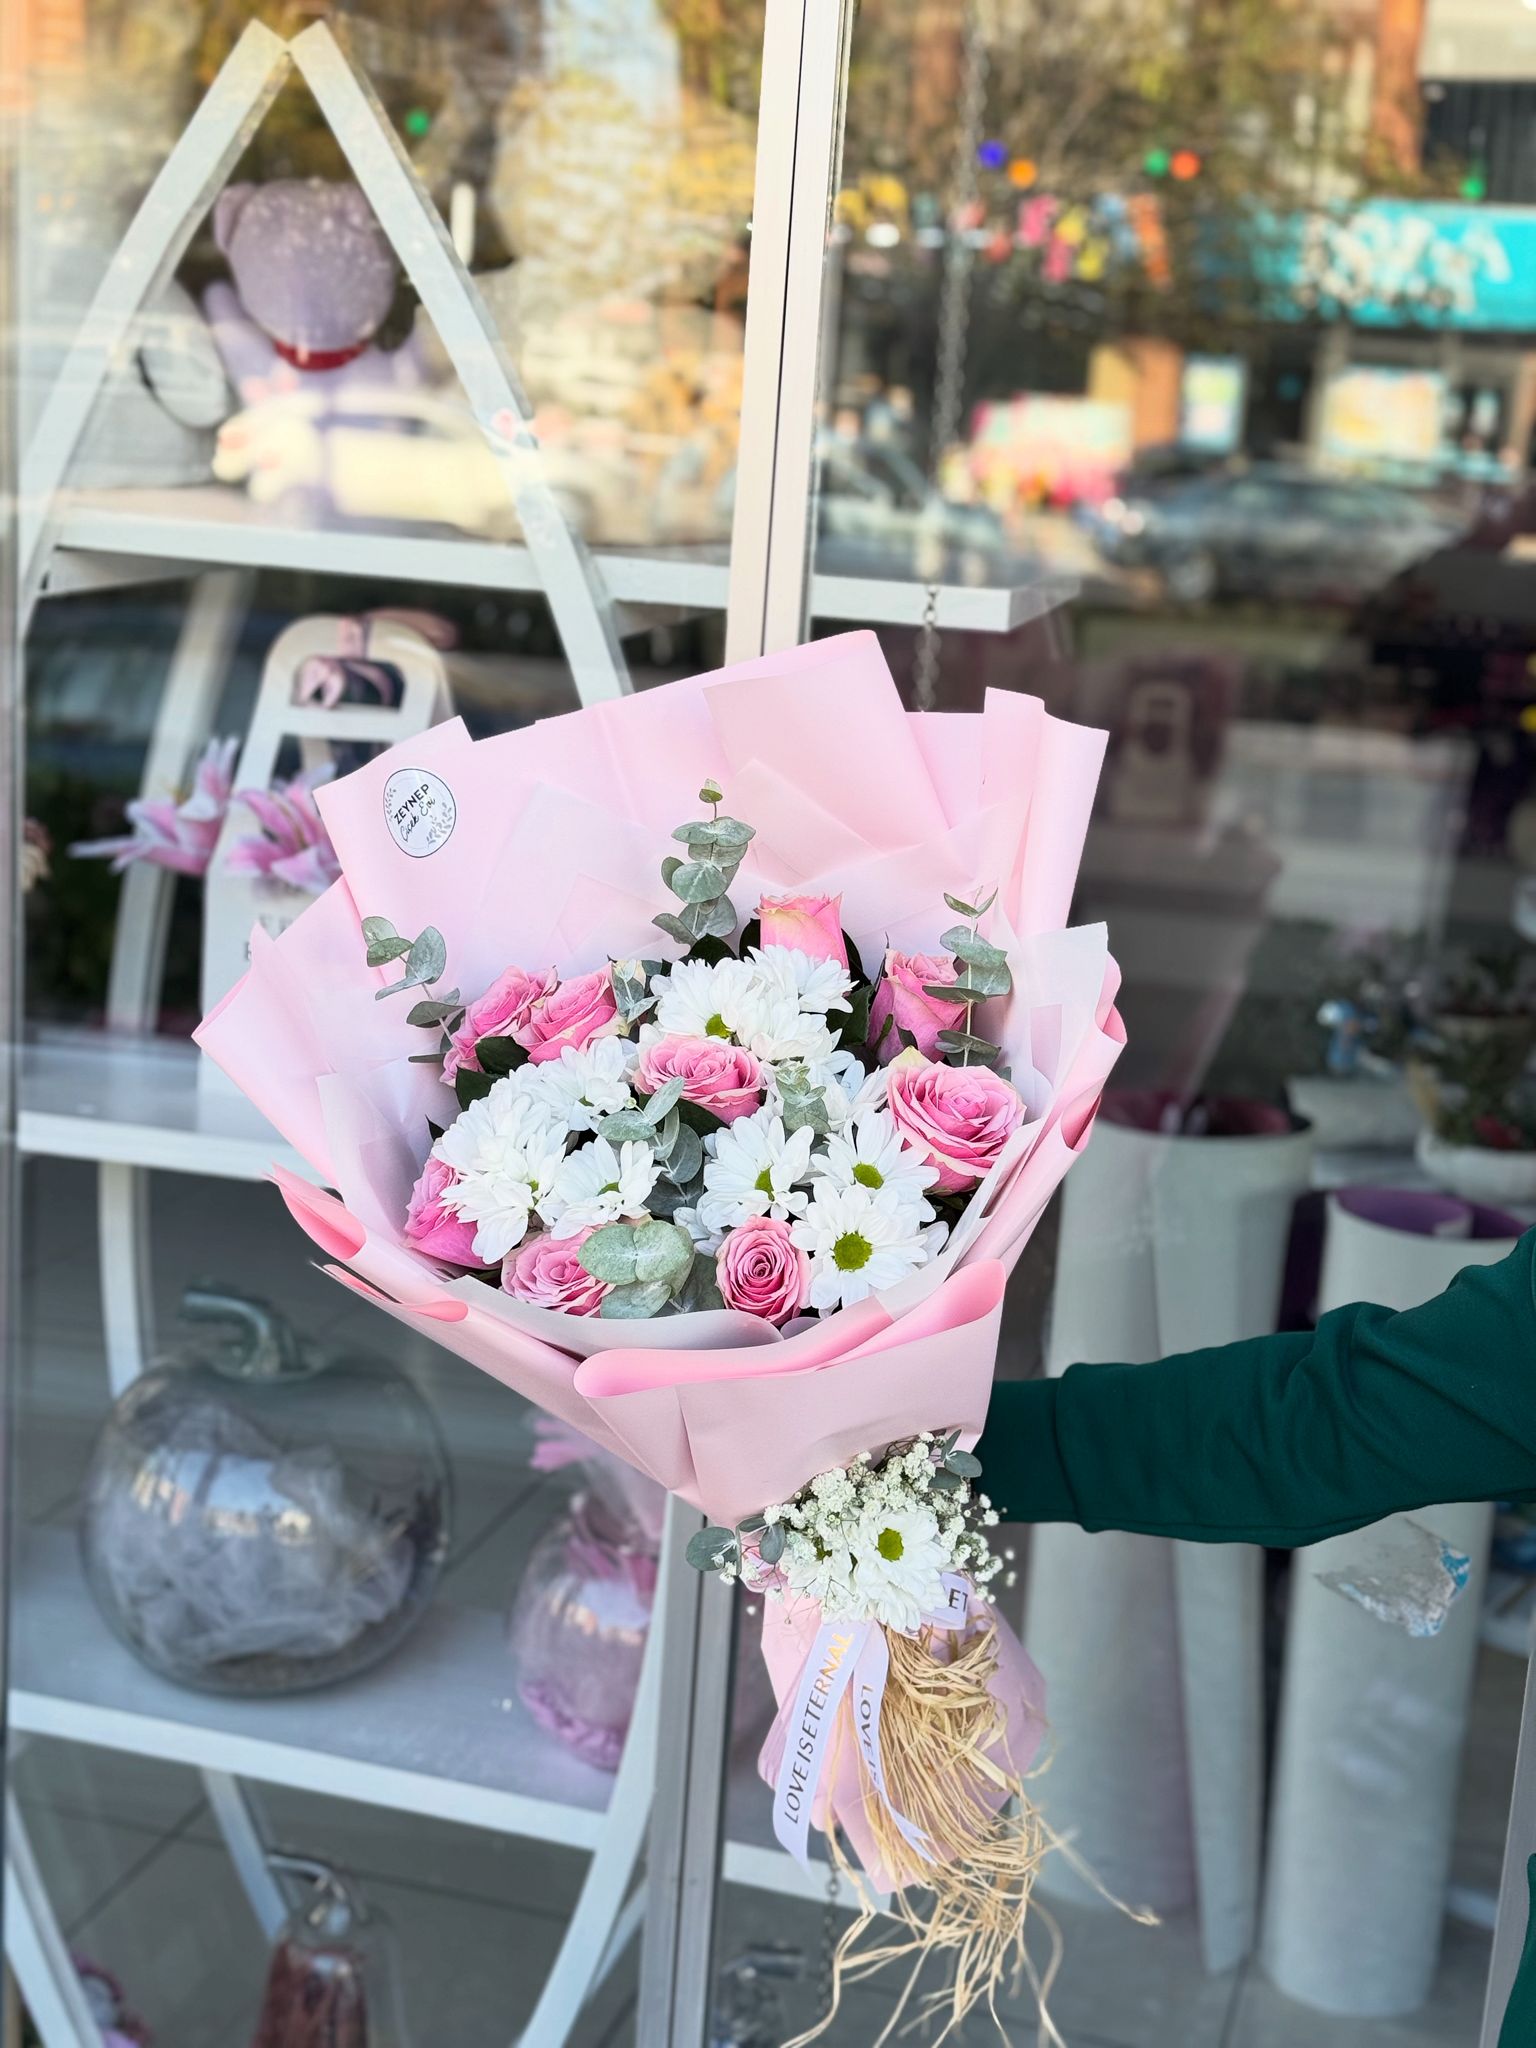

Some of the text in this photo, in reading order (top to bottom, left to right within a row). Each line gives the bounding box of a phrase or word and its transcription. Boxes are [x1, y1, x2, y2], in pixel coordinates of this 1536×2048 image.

[393, 783, 430, 825] ZEYNEP
[784, 1632, 855, 1825] LOVE IS ETERNAL
